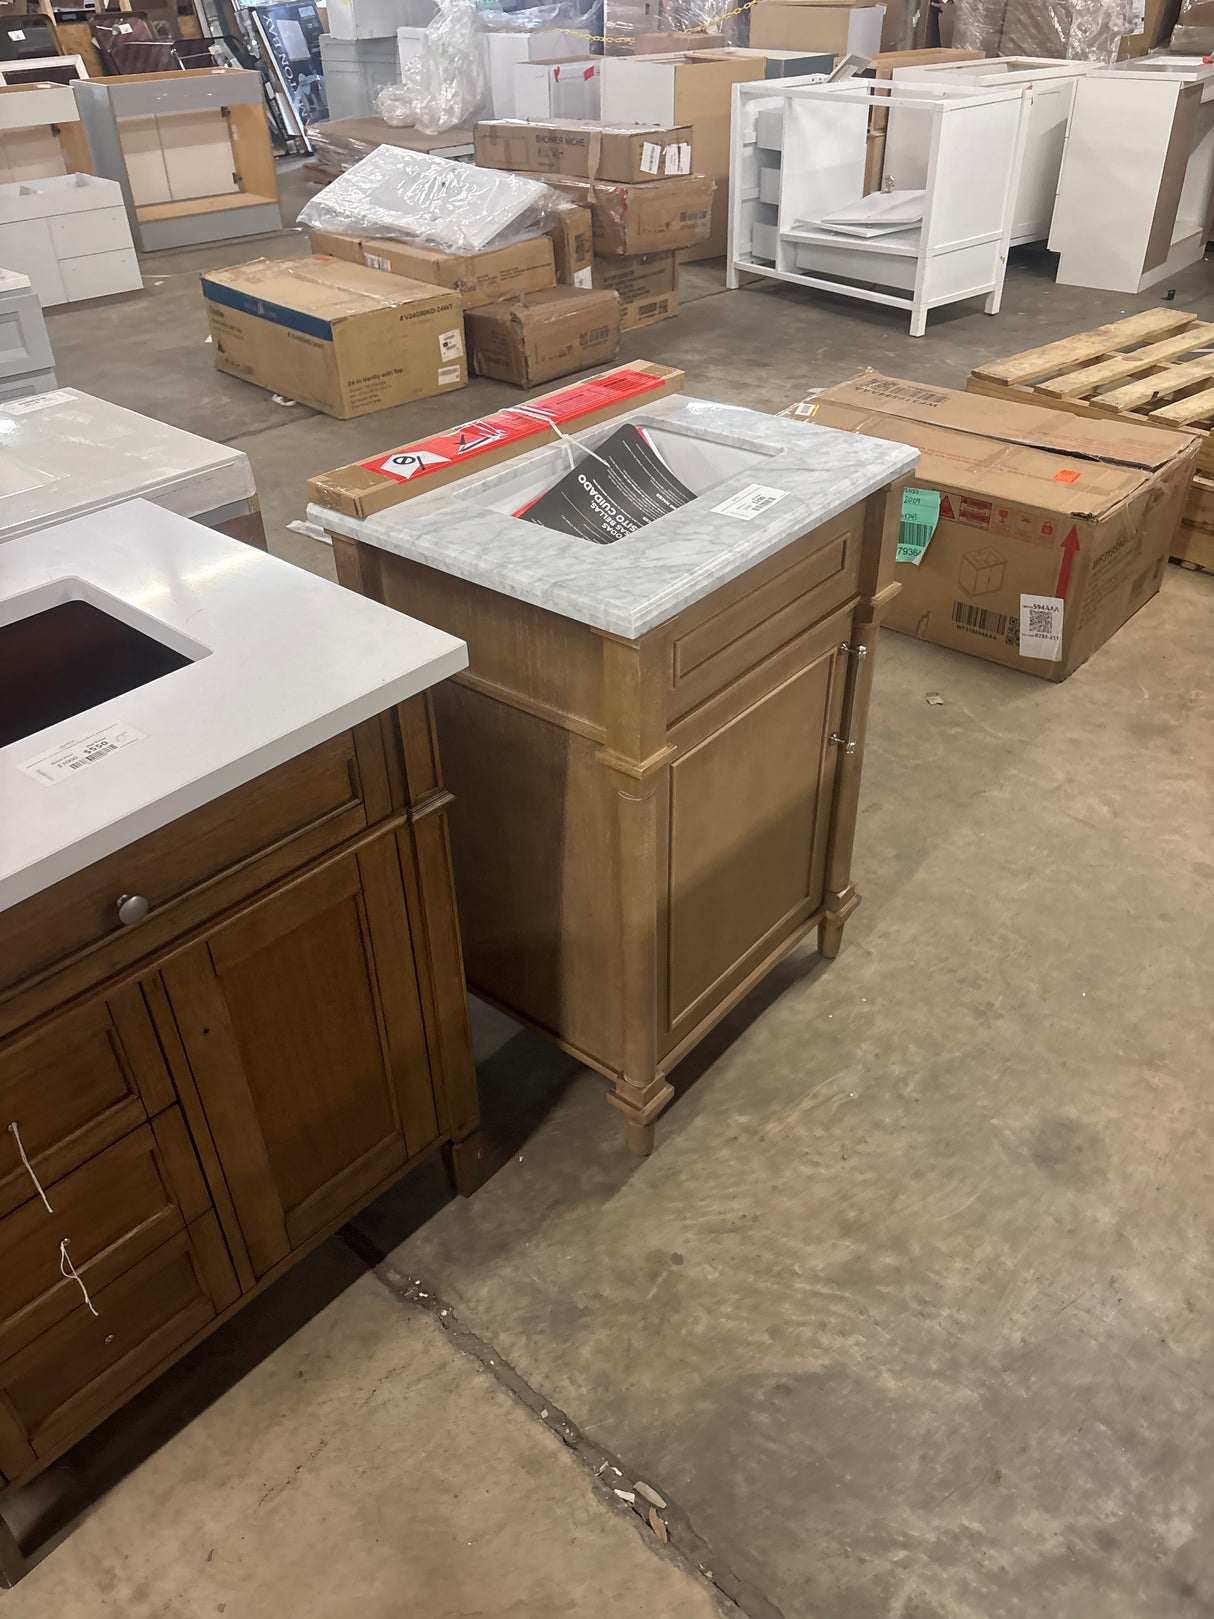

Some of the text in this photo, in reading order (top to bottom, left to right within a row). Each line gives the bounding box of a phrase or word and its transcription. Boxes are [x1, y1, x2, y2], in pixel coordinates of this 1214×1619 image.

[262, 15, 283, 50] BAY
[535, 134, 585, 147] SHOWER NICHE
[578, 474, 617, 515] CUIDADO
[83, 740, 109, 754] $550
